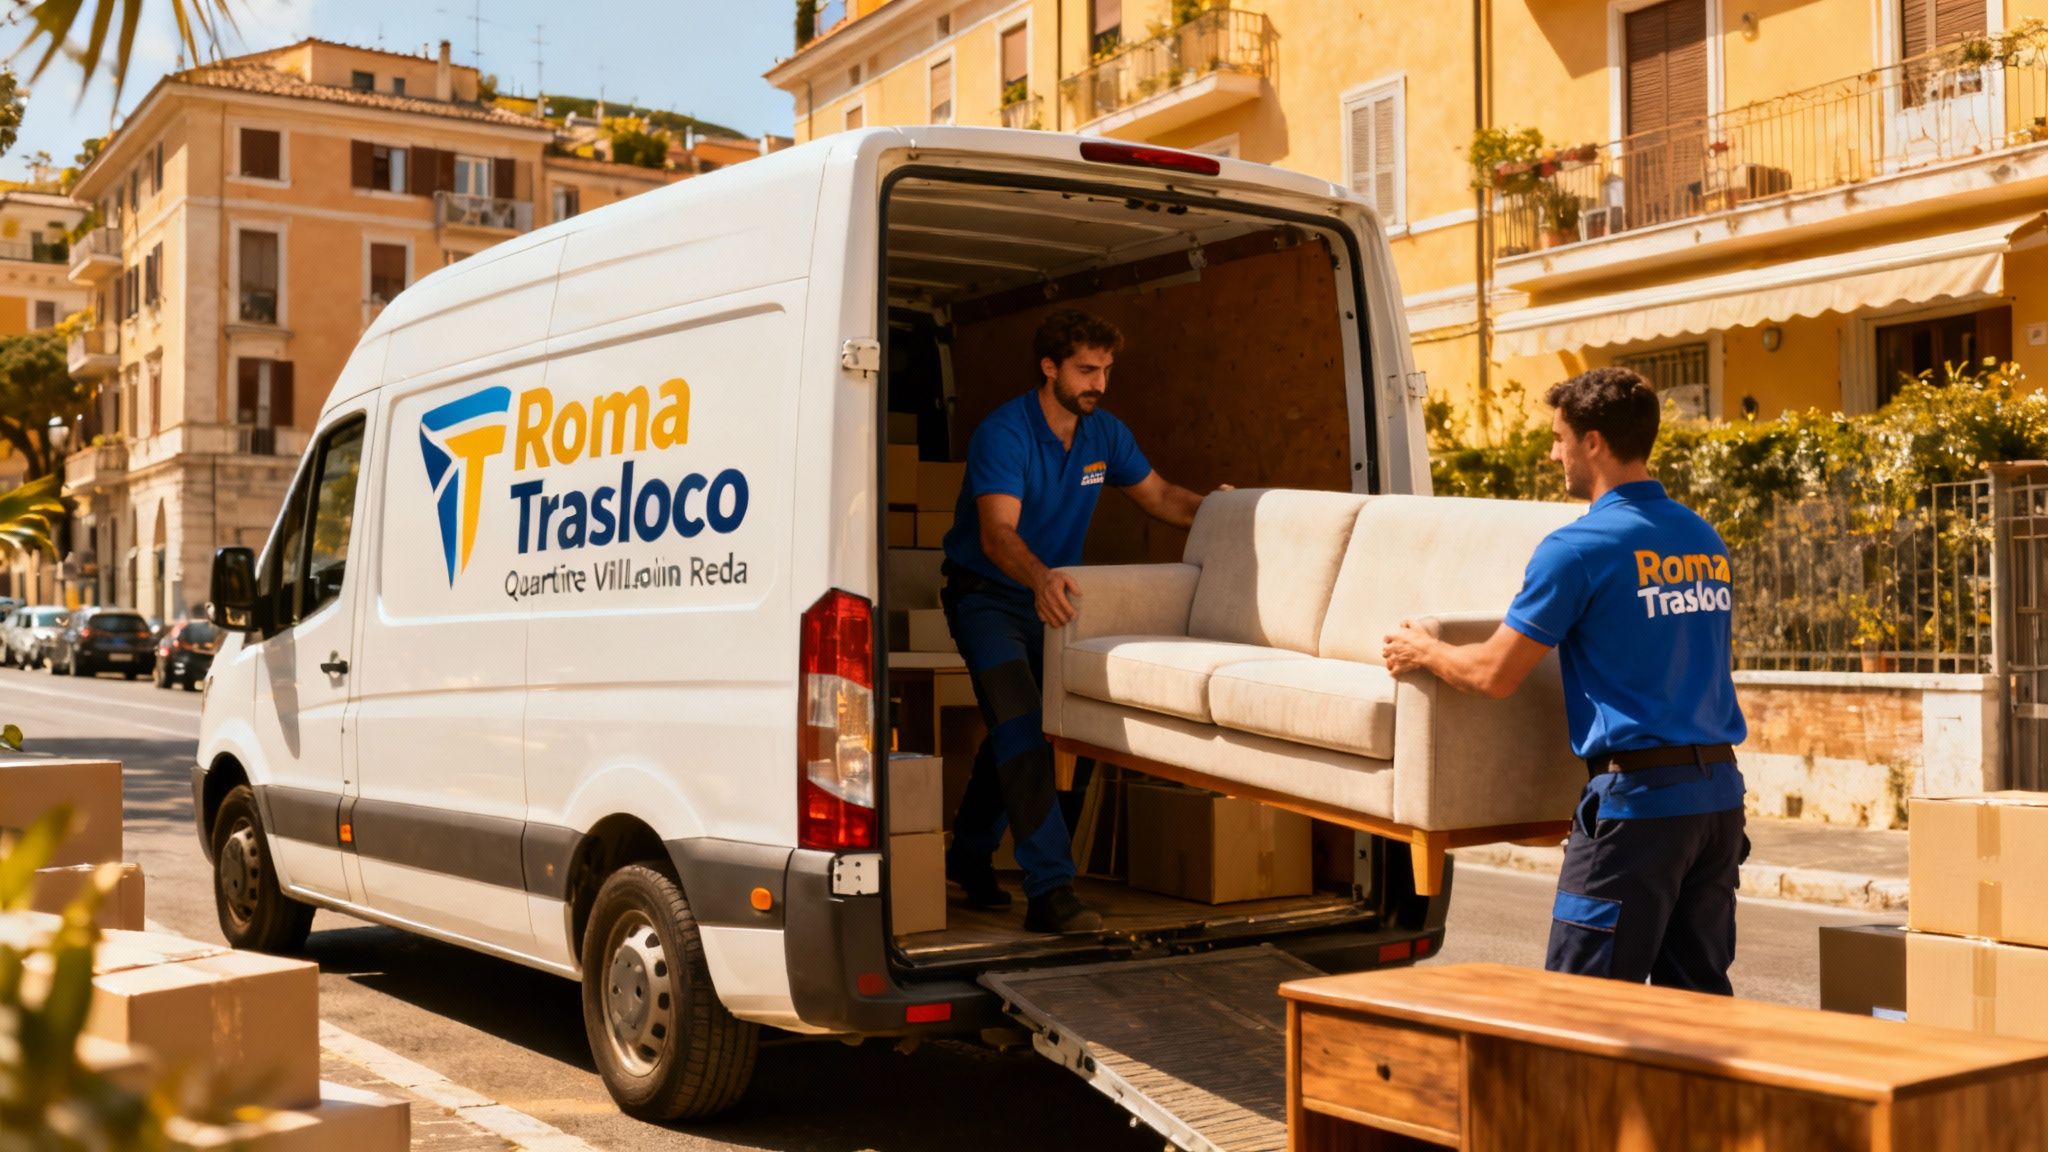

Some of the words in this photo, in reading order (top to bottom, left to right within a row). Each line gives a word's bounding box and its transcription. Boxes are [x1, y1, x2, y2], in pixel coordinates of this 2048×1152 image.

[513, 377, 691, 471] Roma
[510, 460, 749, 554] Trasloco
[690, 552, 747, 586] Reda
[1633, 549, 1731, 587] Roma
